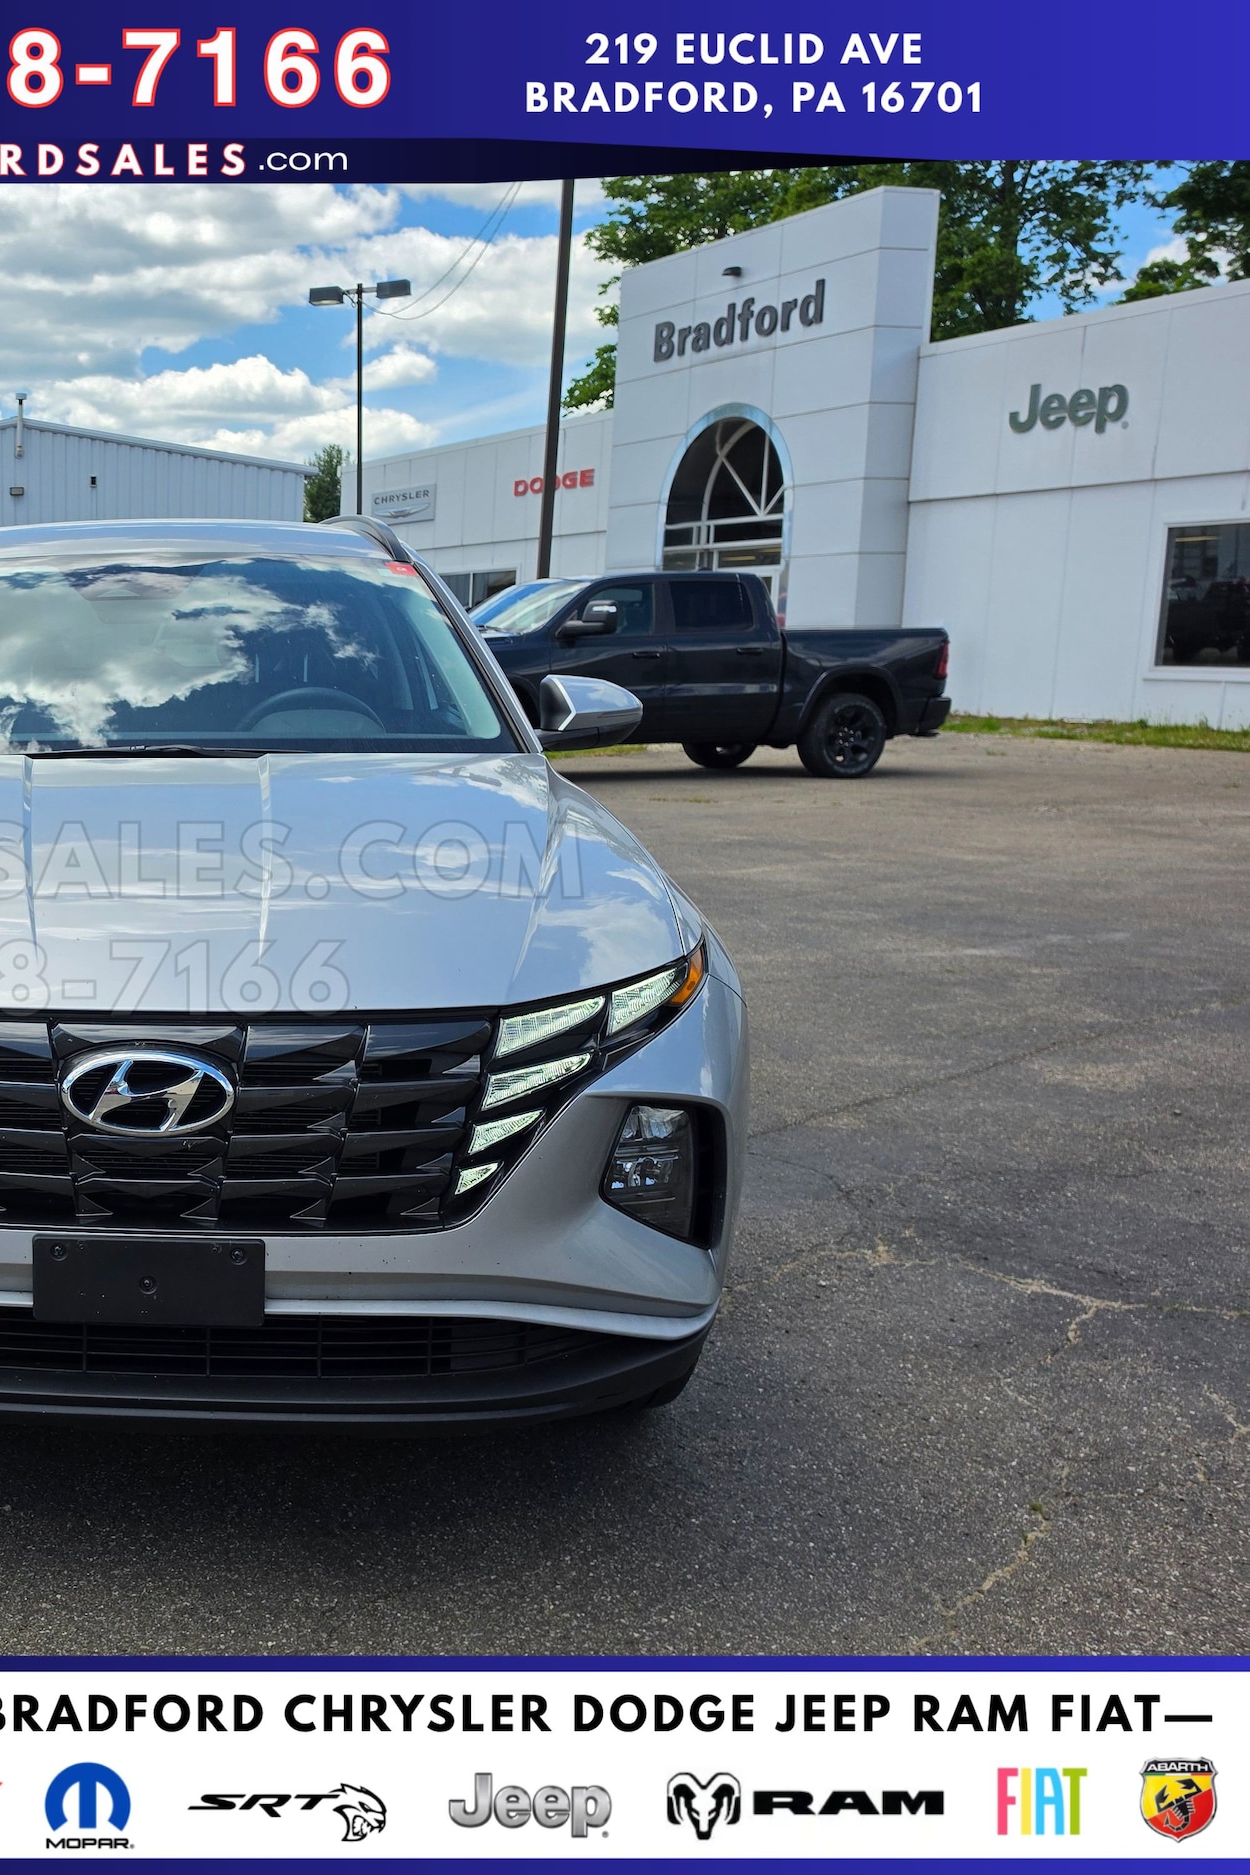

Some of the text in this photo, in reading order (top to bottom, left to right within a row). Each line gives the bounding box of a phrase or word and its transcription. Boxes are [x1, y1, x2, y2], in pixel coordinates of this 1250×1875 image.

[653, 279, 825, 363] Bradford
[1008, 382, 1129, 434] Jeep
[374, 489, 430, 505] CHRYSLER
